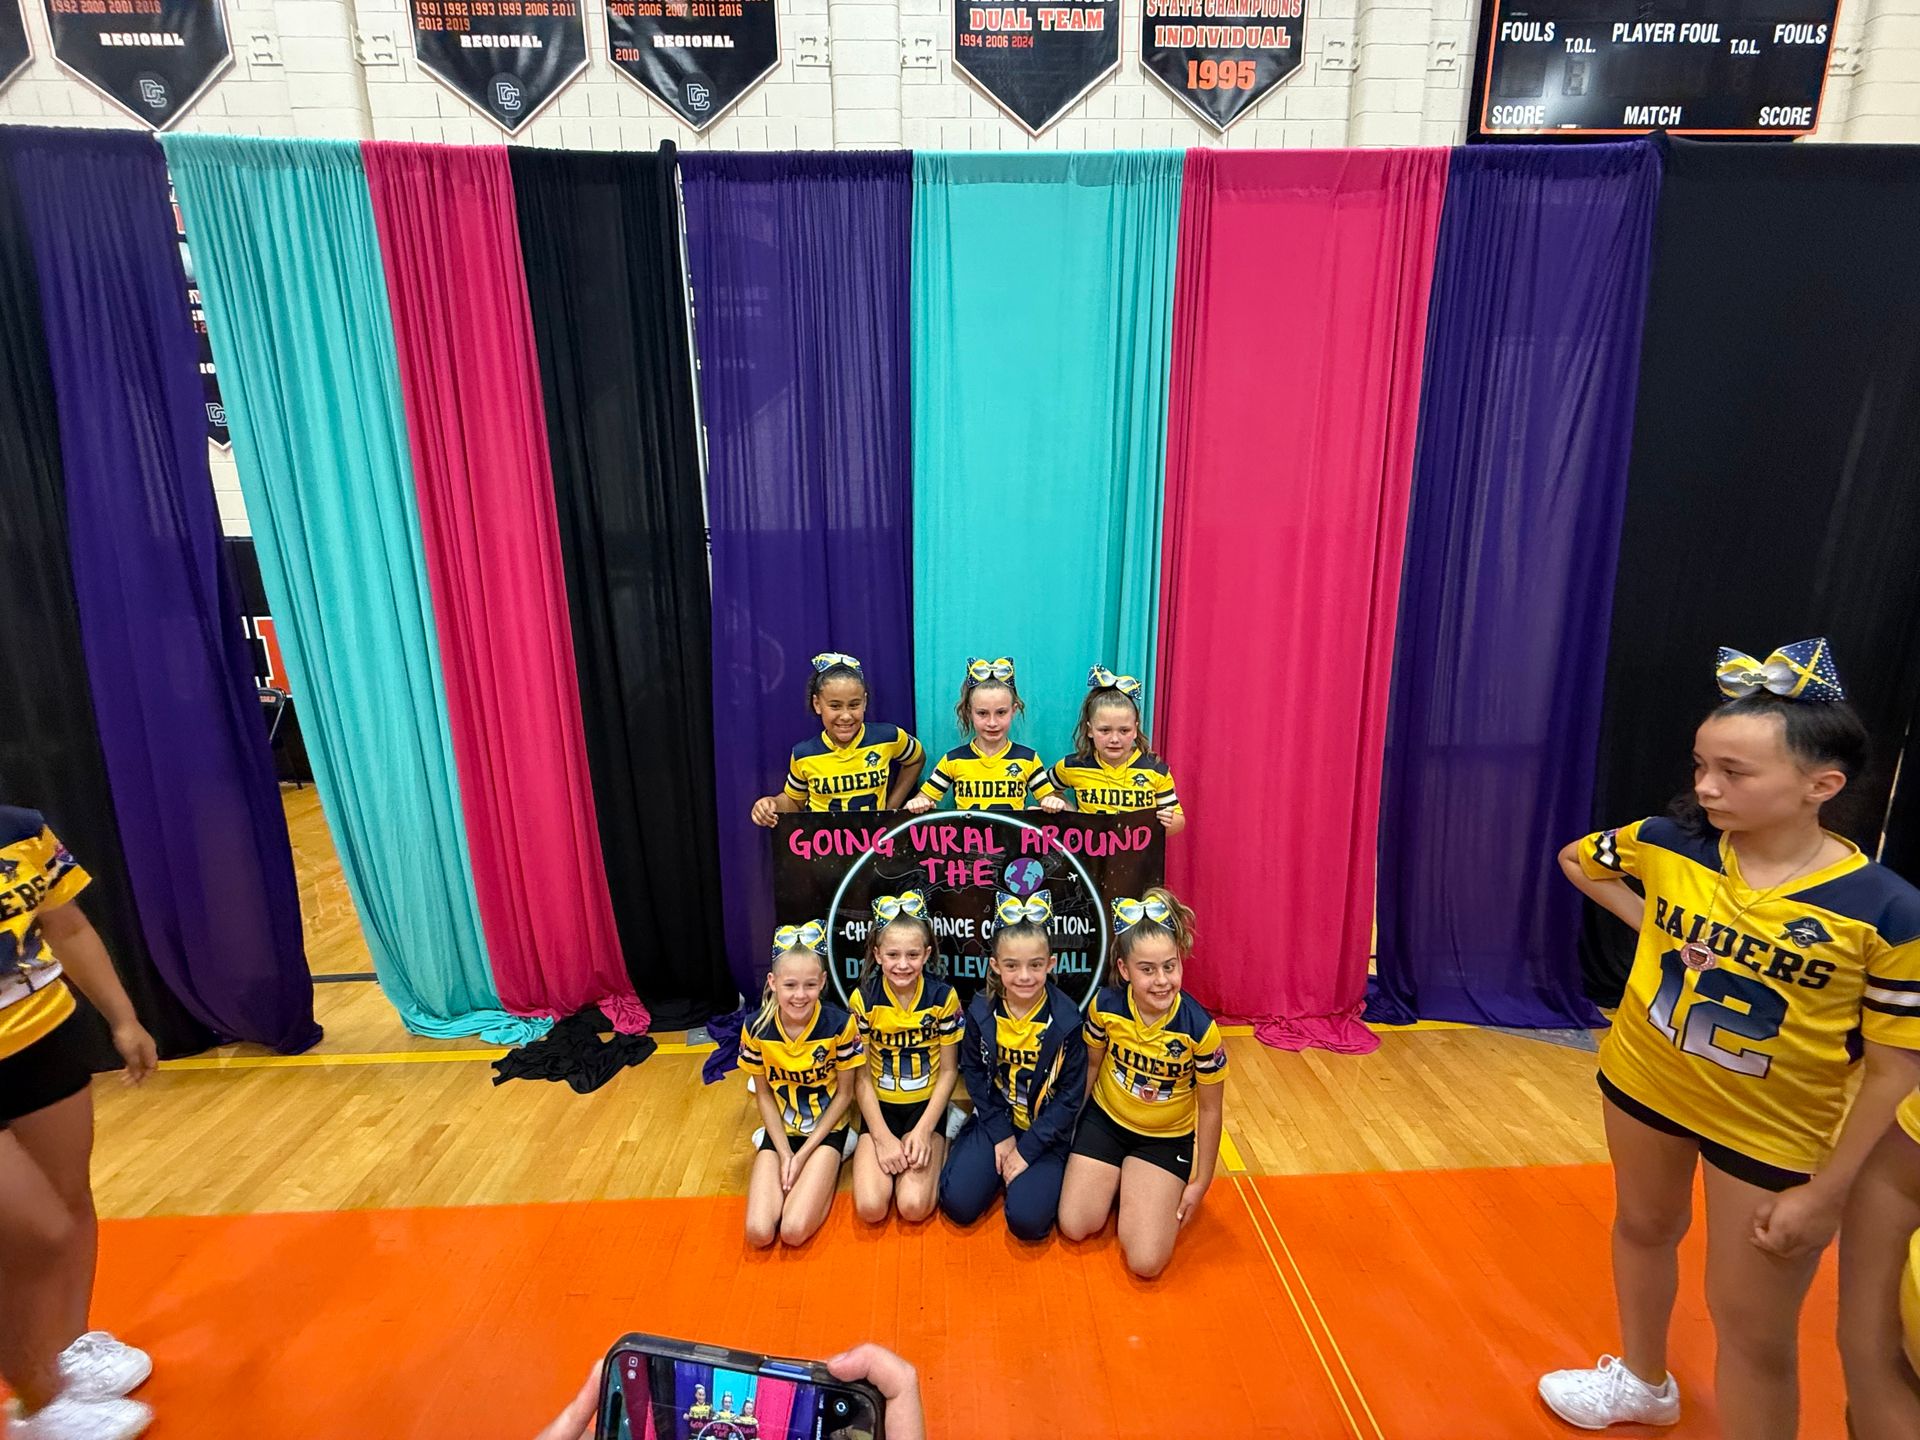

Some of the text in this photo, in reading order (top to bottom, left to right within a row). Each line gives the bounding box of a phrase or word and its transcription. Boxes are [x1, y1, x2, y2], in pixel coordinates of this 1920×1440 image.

[415, 1, 576, 16] 1991 1992 1993 1999 2006 2011
[611, 3, 743, 17] 2005 2006 2007 2011 2016
[1146, 0, 1302, 18] STATE CHAMPIONS
[418, 17, 471, 31] 2012 2019
[969, 8, 1105, 31] DUAL TEAM
[99, 32, 185, 46] REGIONAL
[460, 34, 543, 48] REGIONAL
[652, 35, 735, 48] REGIONAL
[959, 34, 1034, 48] 1994 2006 2024
[1155, 25, 1291, 49] INDIVIDUAL
[1500, 21, 1555, 42] FOULS
[1611, 23, 1721, 44] PLAYER FOUL
[1773, 24, 1828, 44] FOULS
[615, 48, 640, 61] 2010
[1565, 38, 1596, 53] T.O.L.
[1730, 39, 1760, 55] T.O.L.
[1187, 60, 1257, 90] 1995
[1491, 105, 1545, 125] SCORE
[1623, 106, 1682, 126] MATCH
[1758, 106, 1812, 126] SCORE
[811, 768, 887, 795] RAIDERS
[958, 780, 1024, 798] RAIDERS
[788, 824, 1152, 860] GOING VIRAL AROUND
[919, 857, 994, 887] THE
[1655, 895, 1837, 990] RAIDERS
[1648, 948, 1789, 1079] 12
[878, 1047, 932, 1092] 10
